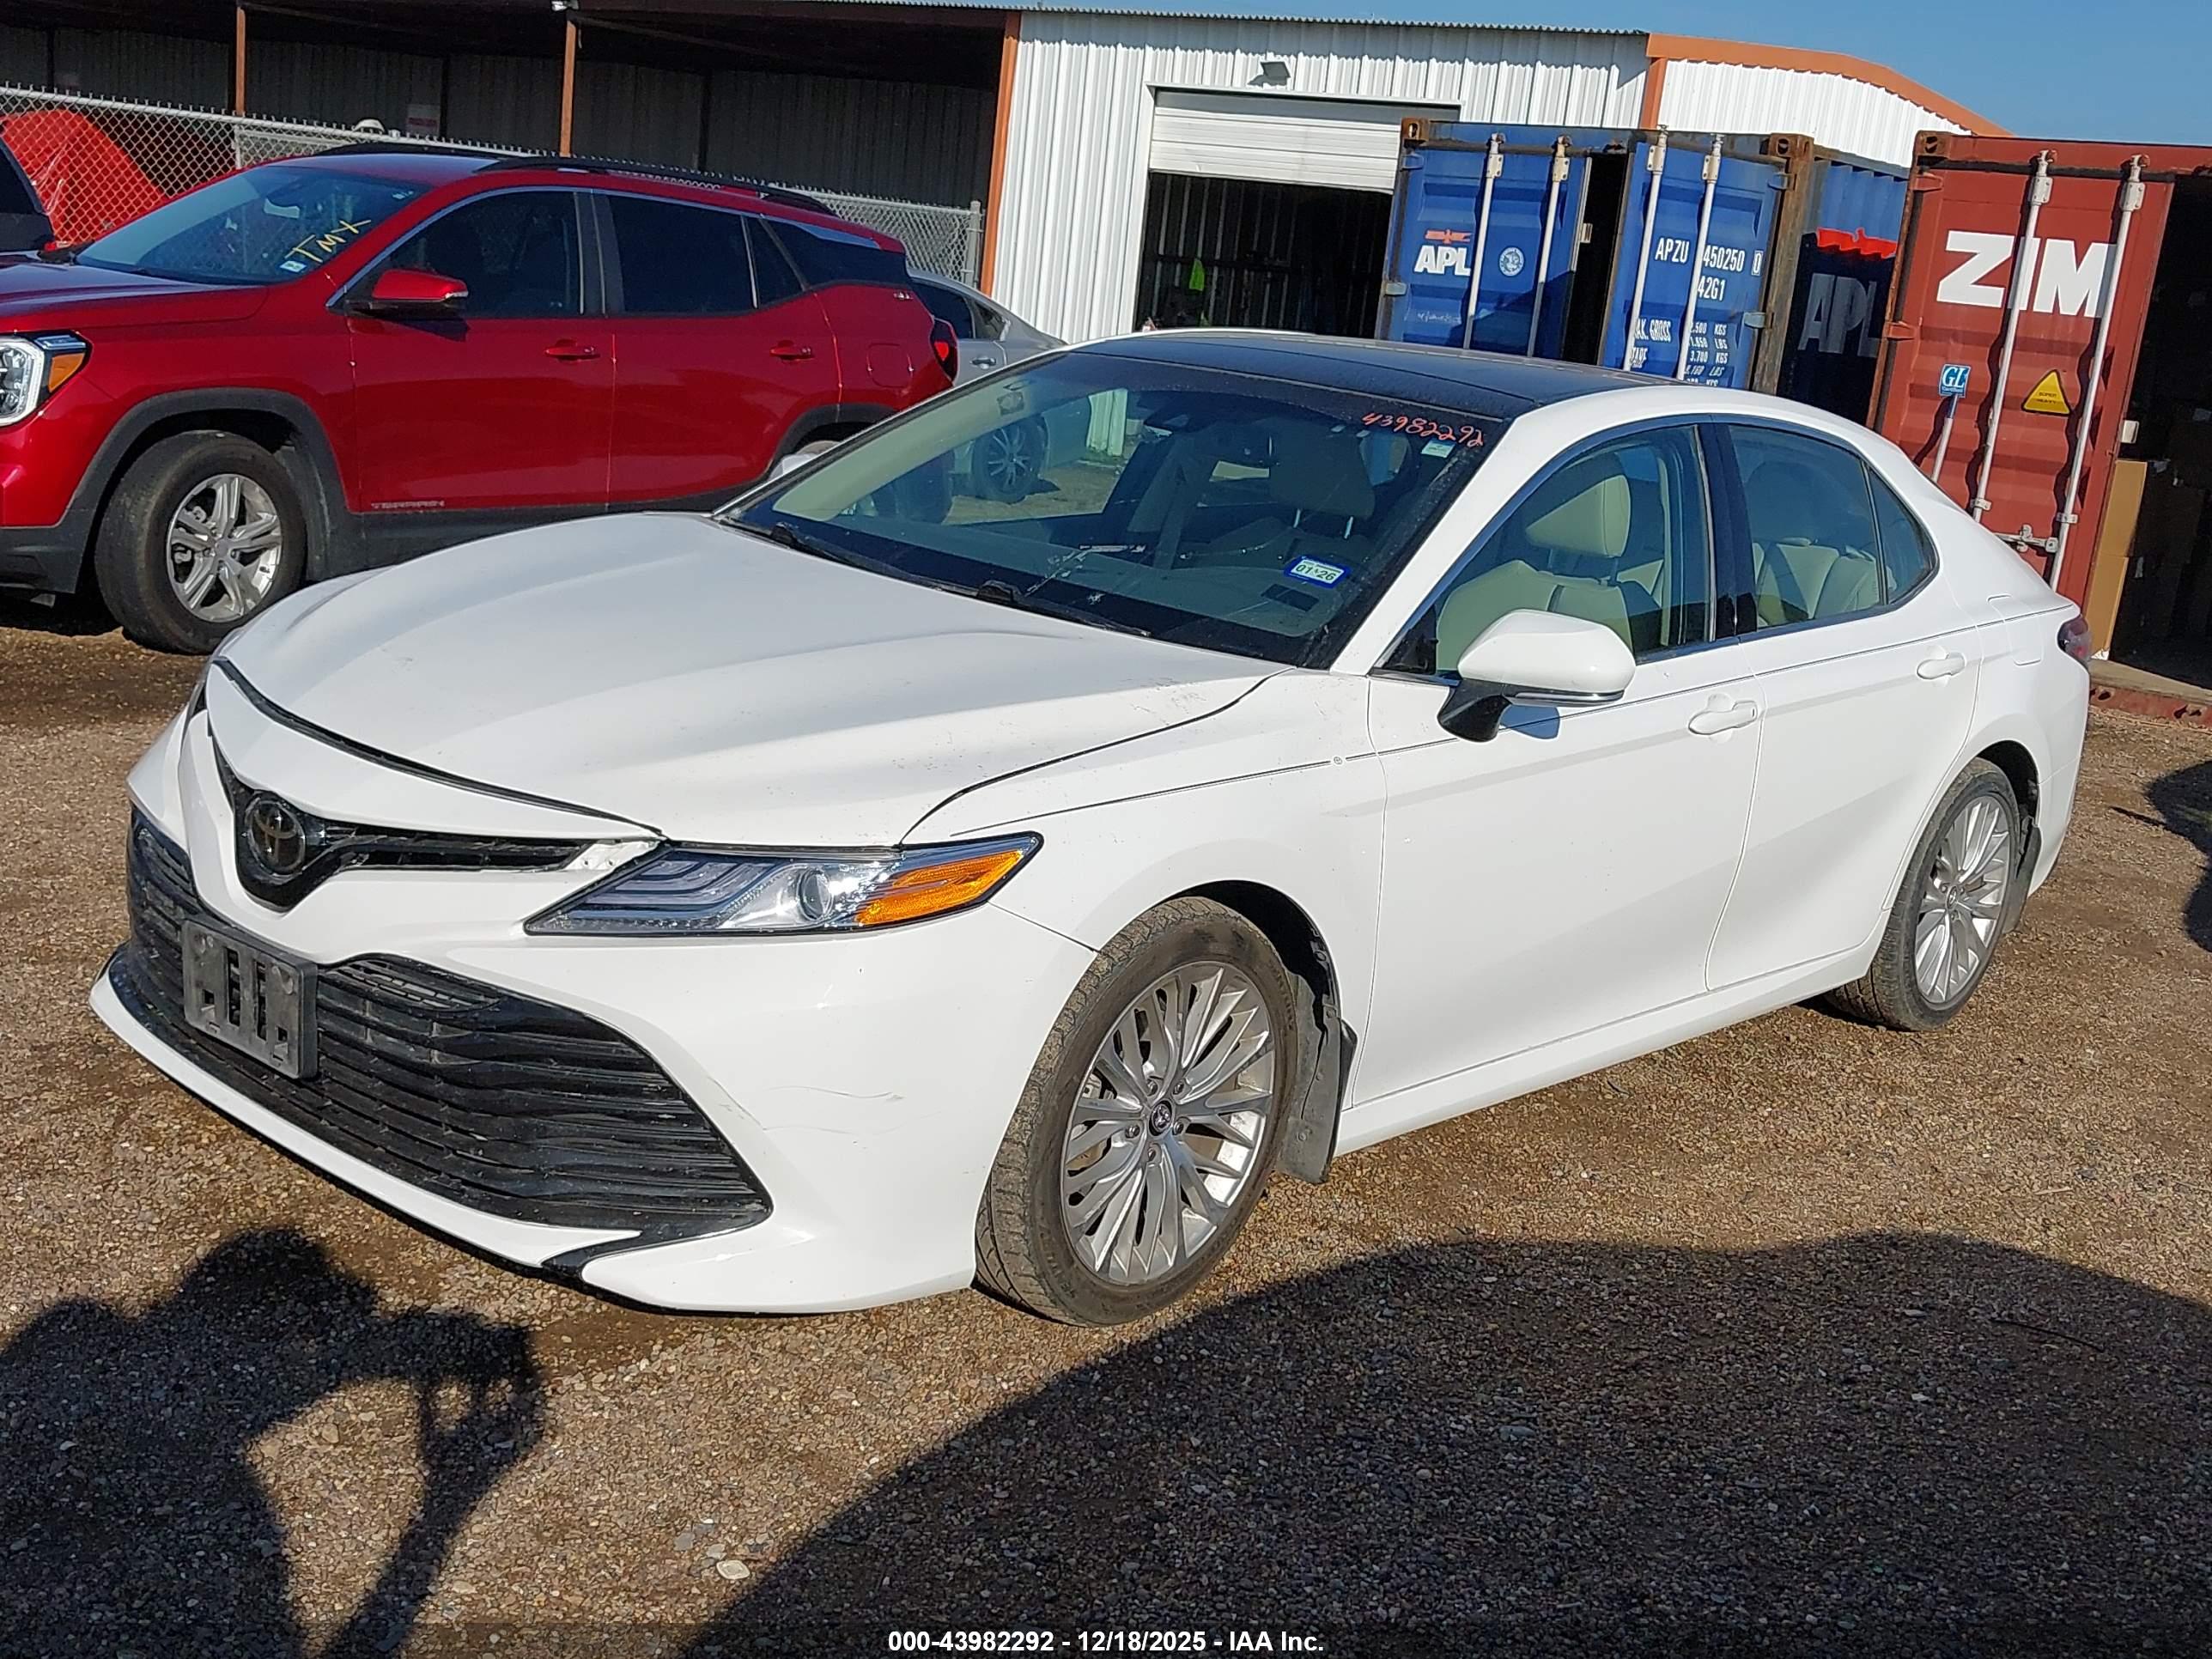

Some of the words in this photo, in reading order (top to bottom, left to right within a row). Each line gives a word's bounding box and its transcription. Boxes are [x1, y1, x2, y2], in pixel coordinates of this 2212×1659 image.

[284, 219, 372, 263] TMX
[1654, 237, 1690, 264] APZU
[1703, 245, 1746, 272] 450250
[1413, 245, 1471, 276] APL
[1936, 230, 2120, 318] ZIM
[1697, 276, 1726, 301] 42G1
[1797, 272, 1881, 358] APL
[1942, 367, 1967, 387] GL
[1362, 412, 1484, 447] 43982292
